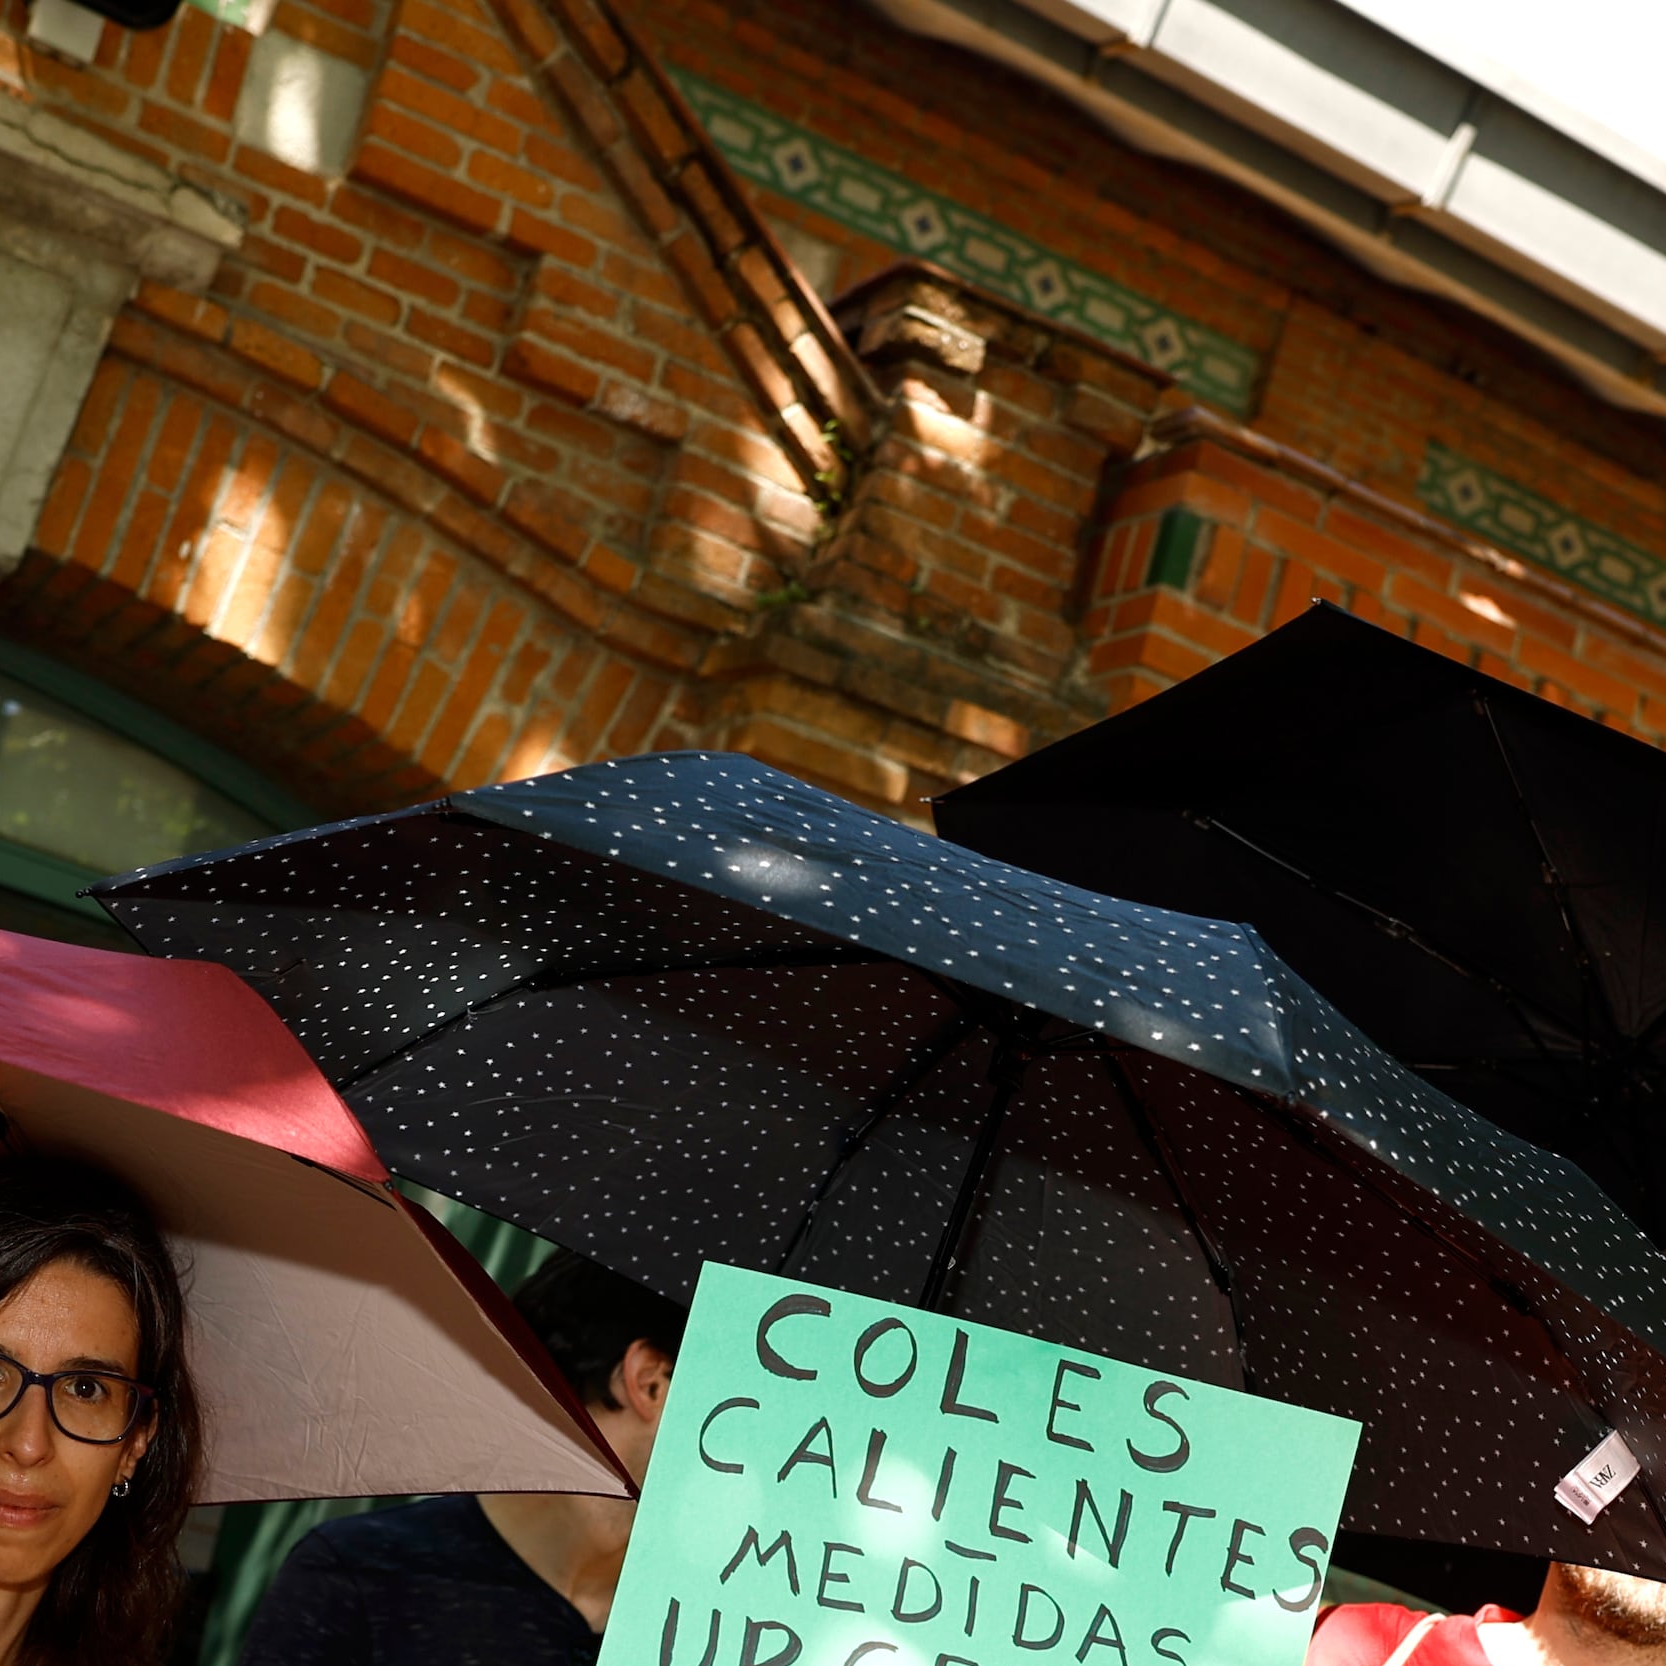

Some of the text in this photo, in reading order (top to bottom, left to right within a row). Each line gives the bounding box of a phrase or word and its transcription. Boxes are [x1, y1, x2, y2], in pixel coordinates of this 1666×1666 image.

[757, 1294, 1190, 1473] COLES
[699, 1397, 1328, 1612] CALIENTES
[1589, 1464, 1616, 1489] ZARA
